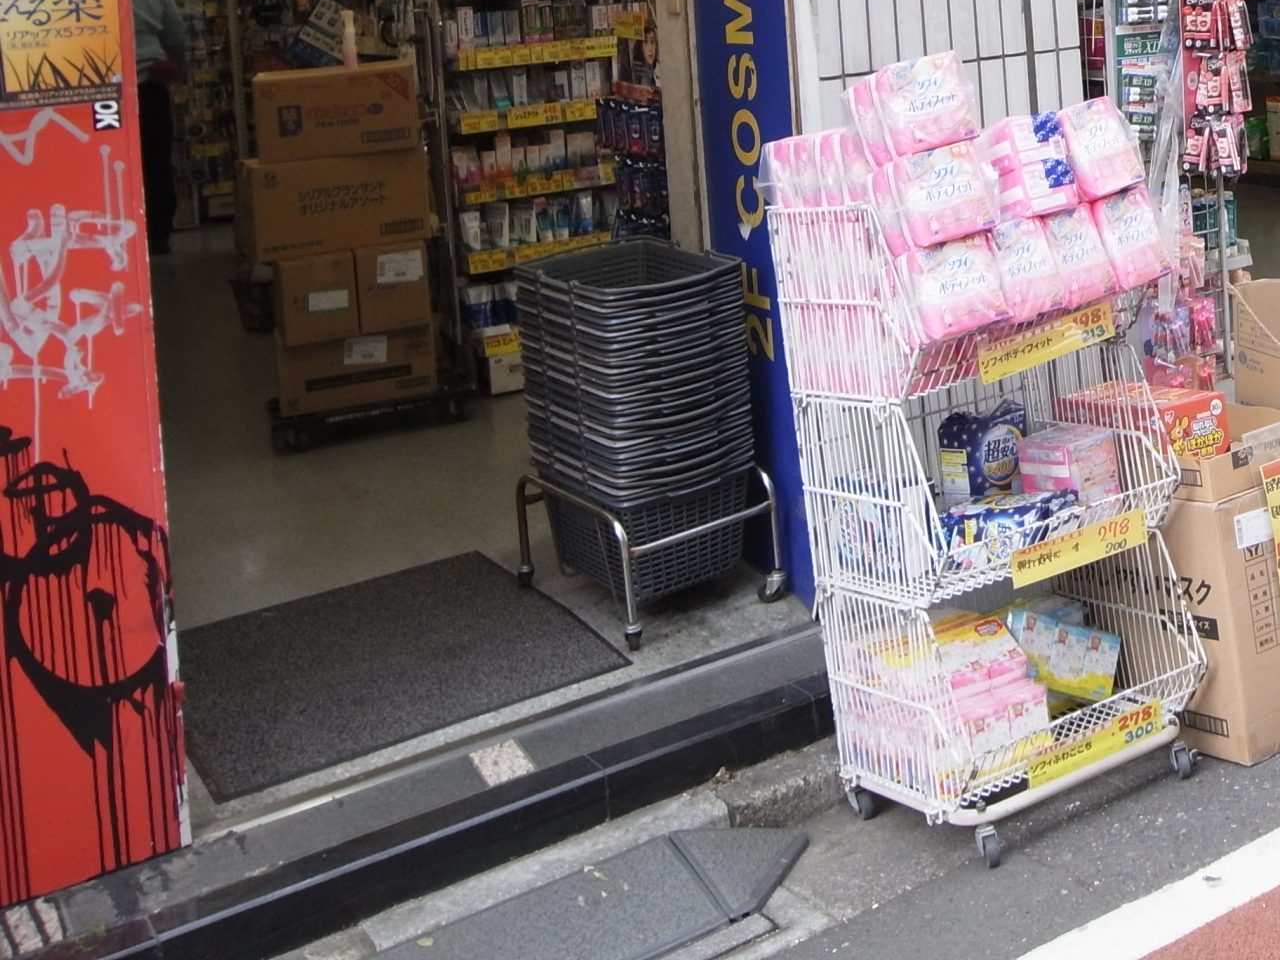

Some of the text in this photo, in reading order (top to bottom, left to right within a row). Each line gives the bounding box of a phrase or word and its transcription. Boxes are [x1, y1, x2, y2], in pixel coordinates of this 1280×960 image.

[94, 101, 120, 129] OK
[742, 268, 774, 362] 2F
[982, 337, 1052, 369] ソフィボディフィット
[1098, 518, 1130, 542] 278
[1118, 705, 1152, 732] 278
[1124, 722, 1154, 744] 300
